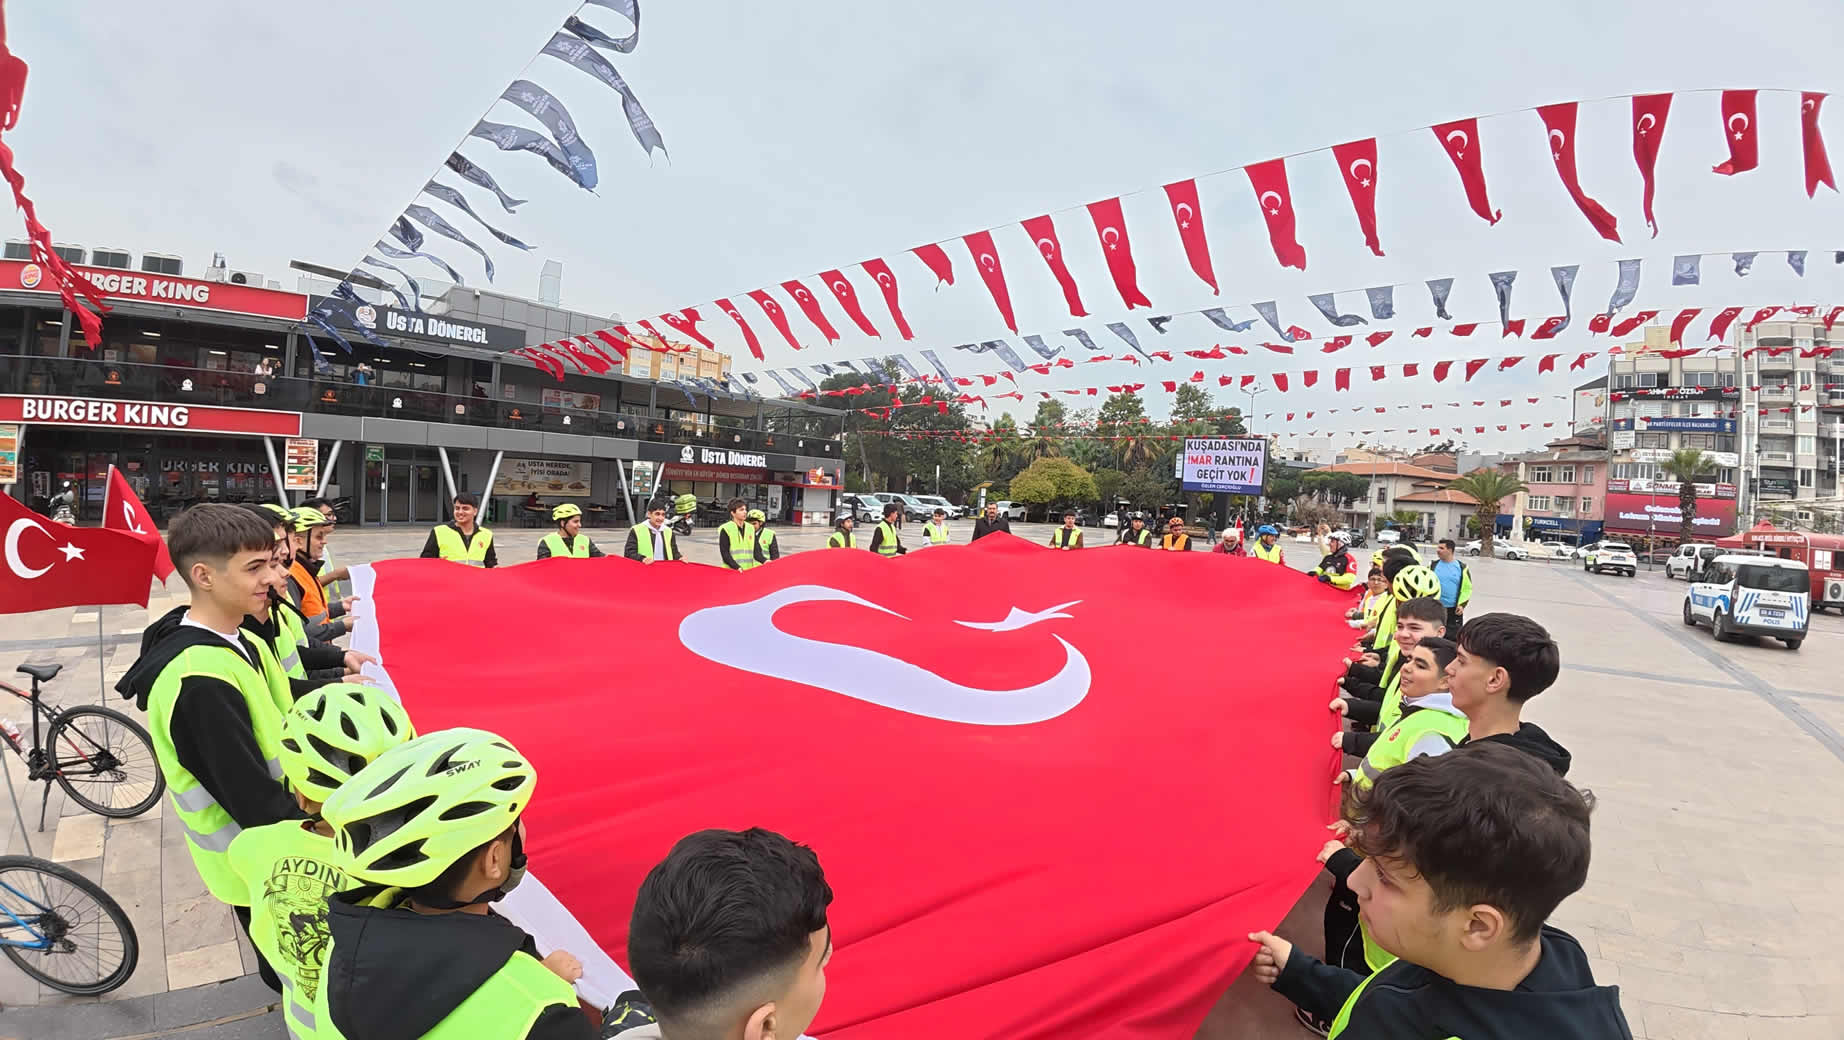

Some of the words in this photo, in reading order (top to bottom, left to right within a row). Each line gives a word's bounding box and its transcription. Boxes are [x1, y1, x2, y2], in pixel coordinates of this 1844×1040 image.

[76, 270, 147, 296] RGER
[152, 279, 209, 303] KING
[386, 311, 424, 334] USTA
[427, 318, 489, 344] DÖNERCİ
[22, 398, 117, 422] BURGER
[124, 403, 190, 427] KING
[1187, 440, 1262, 454] KUŞADASI'NDA
[701, 449, 727, 464] USTA
[728, 450, 767, 467] DÖNERCİ
[1187, 452, 1212, 465] İMAR
[1214, 456, 1259, 466] RANTINA
[1196, 467, 1225, 482] GEÇİT
[446, 759, 481, 777] SWAY
[280, 858, 341, 889] AYDIN
